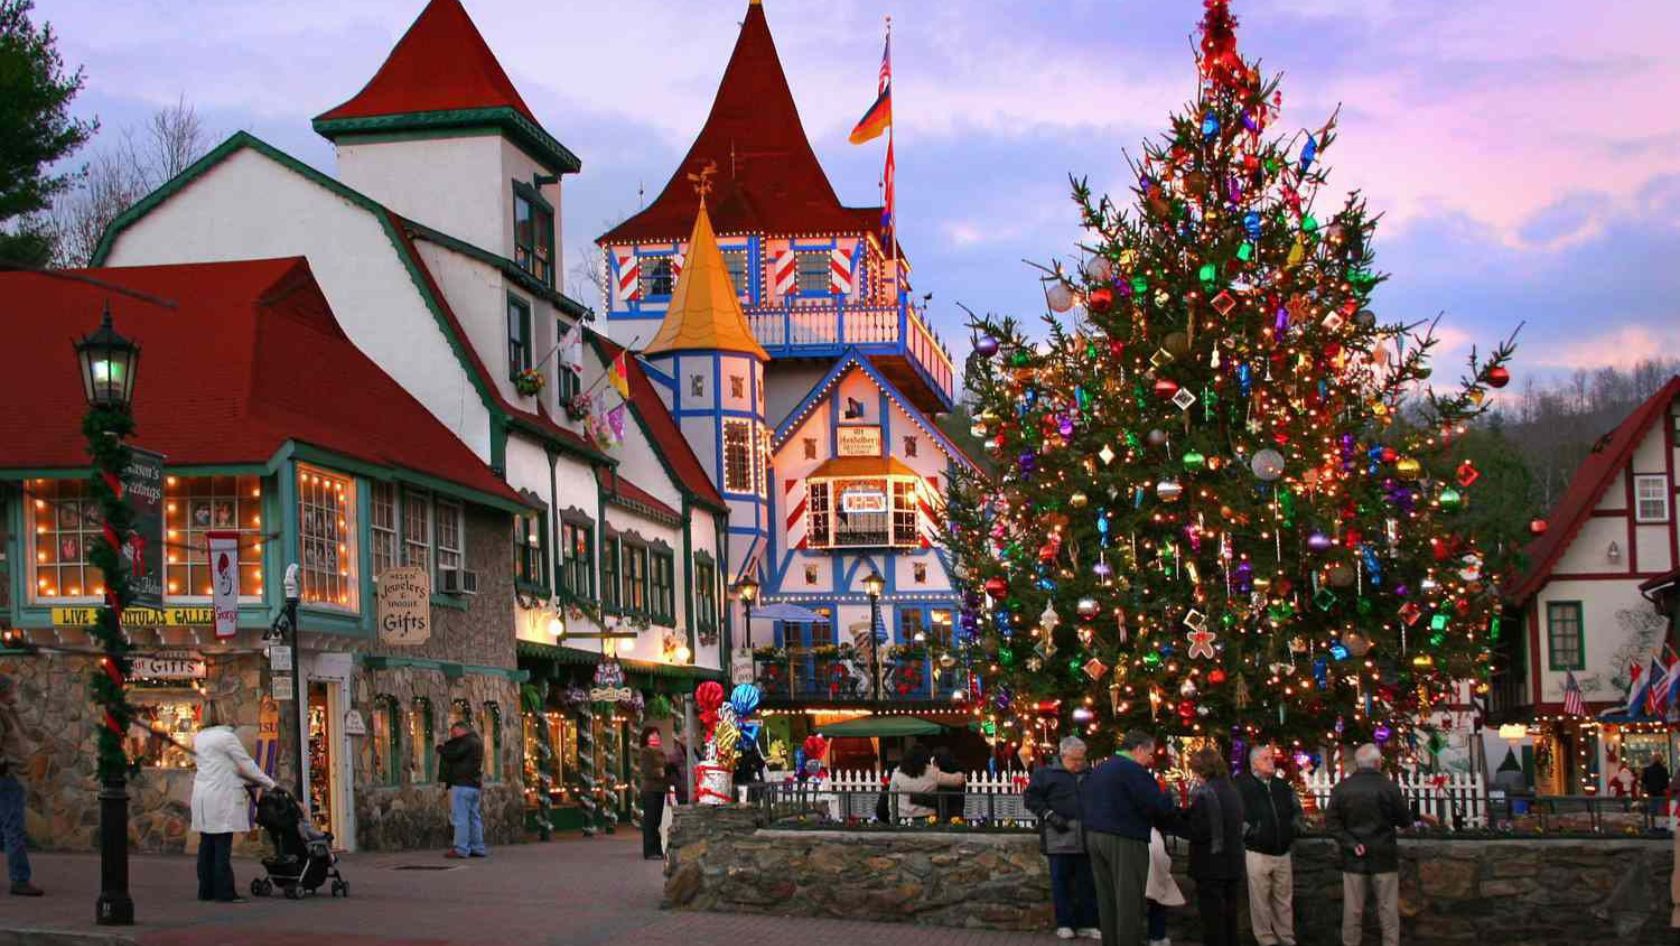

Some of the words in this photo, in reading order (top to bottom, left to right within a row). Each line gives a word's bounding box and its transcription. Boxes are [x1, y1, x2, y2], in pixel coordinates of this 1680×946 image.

[381, 580, 426, 599] Jewelers
[62, 609, 89, 624] LIVE
[120, 609, 167, 625] ANTULAS
[175, 609, 214, 625] GALLE
[384, 611, 425, 633] Gifts
